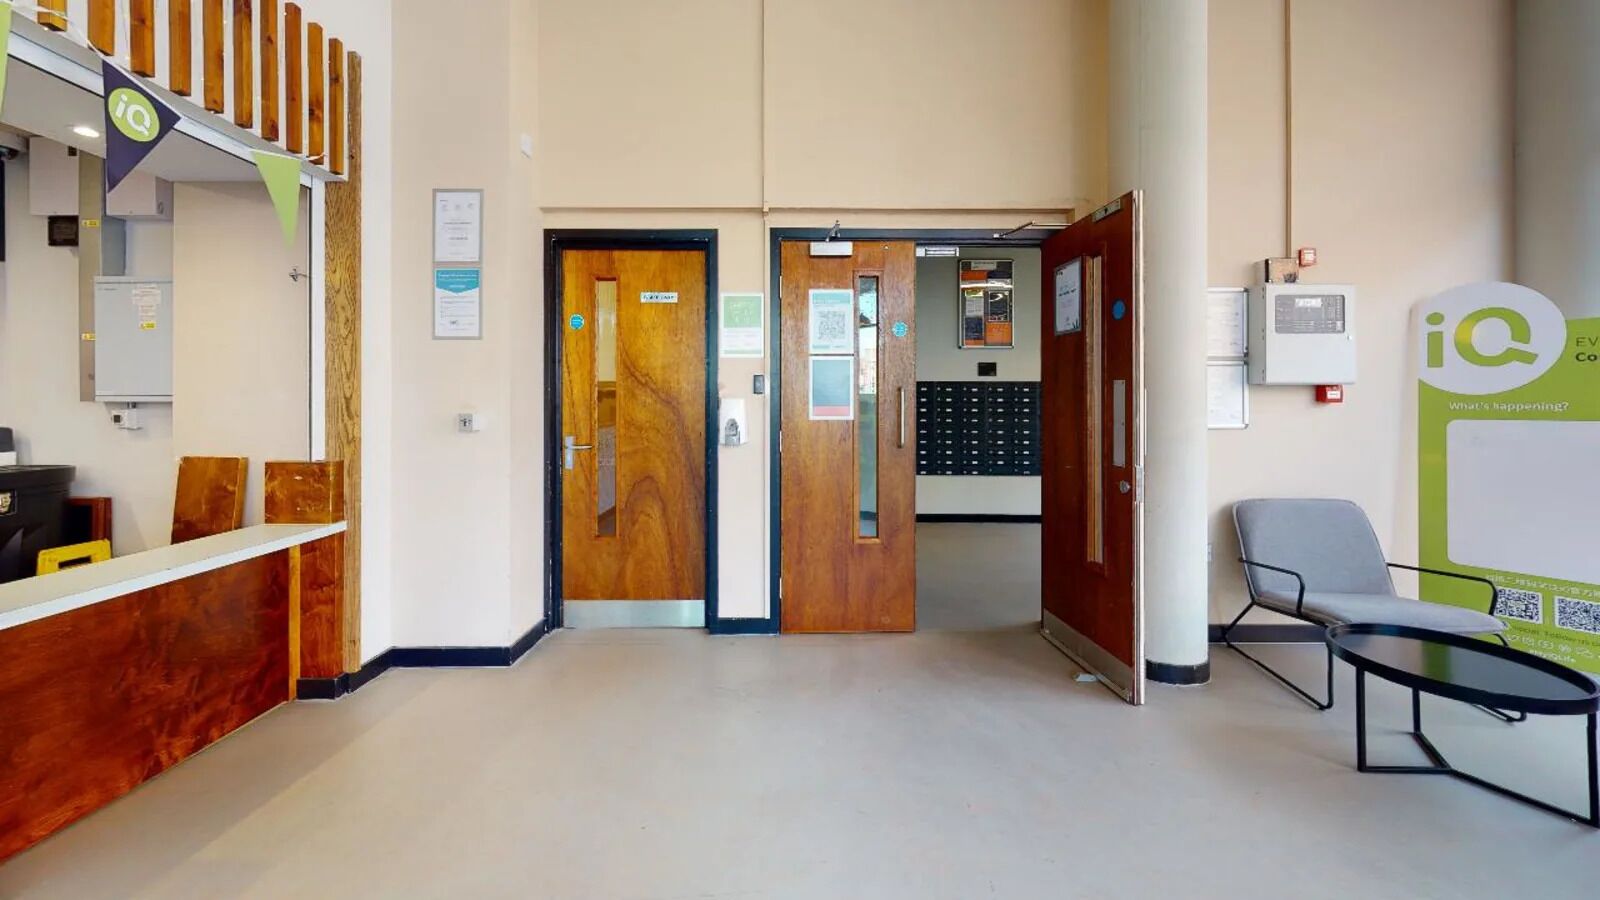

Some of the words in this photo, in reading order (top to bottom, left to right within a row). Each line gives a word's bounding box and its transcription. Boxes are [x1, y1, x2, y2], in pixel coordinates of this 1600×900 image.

[115, 93, 151, 136] iQ
[1425, 307, 1539, 367] iQ
[1575, 352, 1598, 362] Co
[1449, 401, 1489, 411] What's
[1493, 402, 1569, 412] happening?
